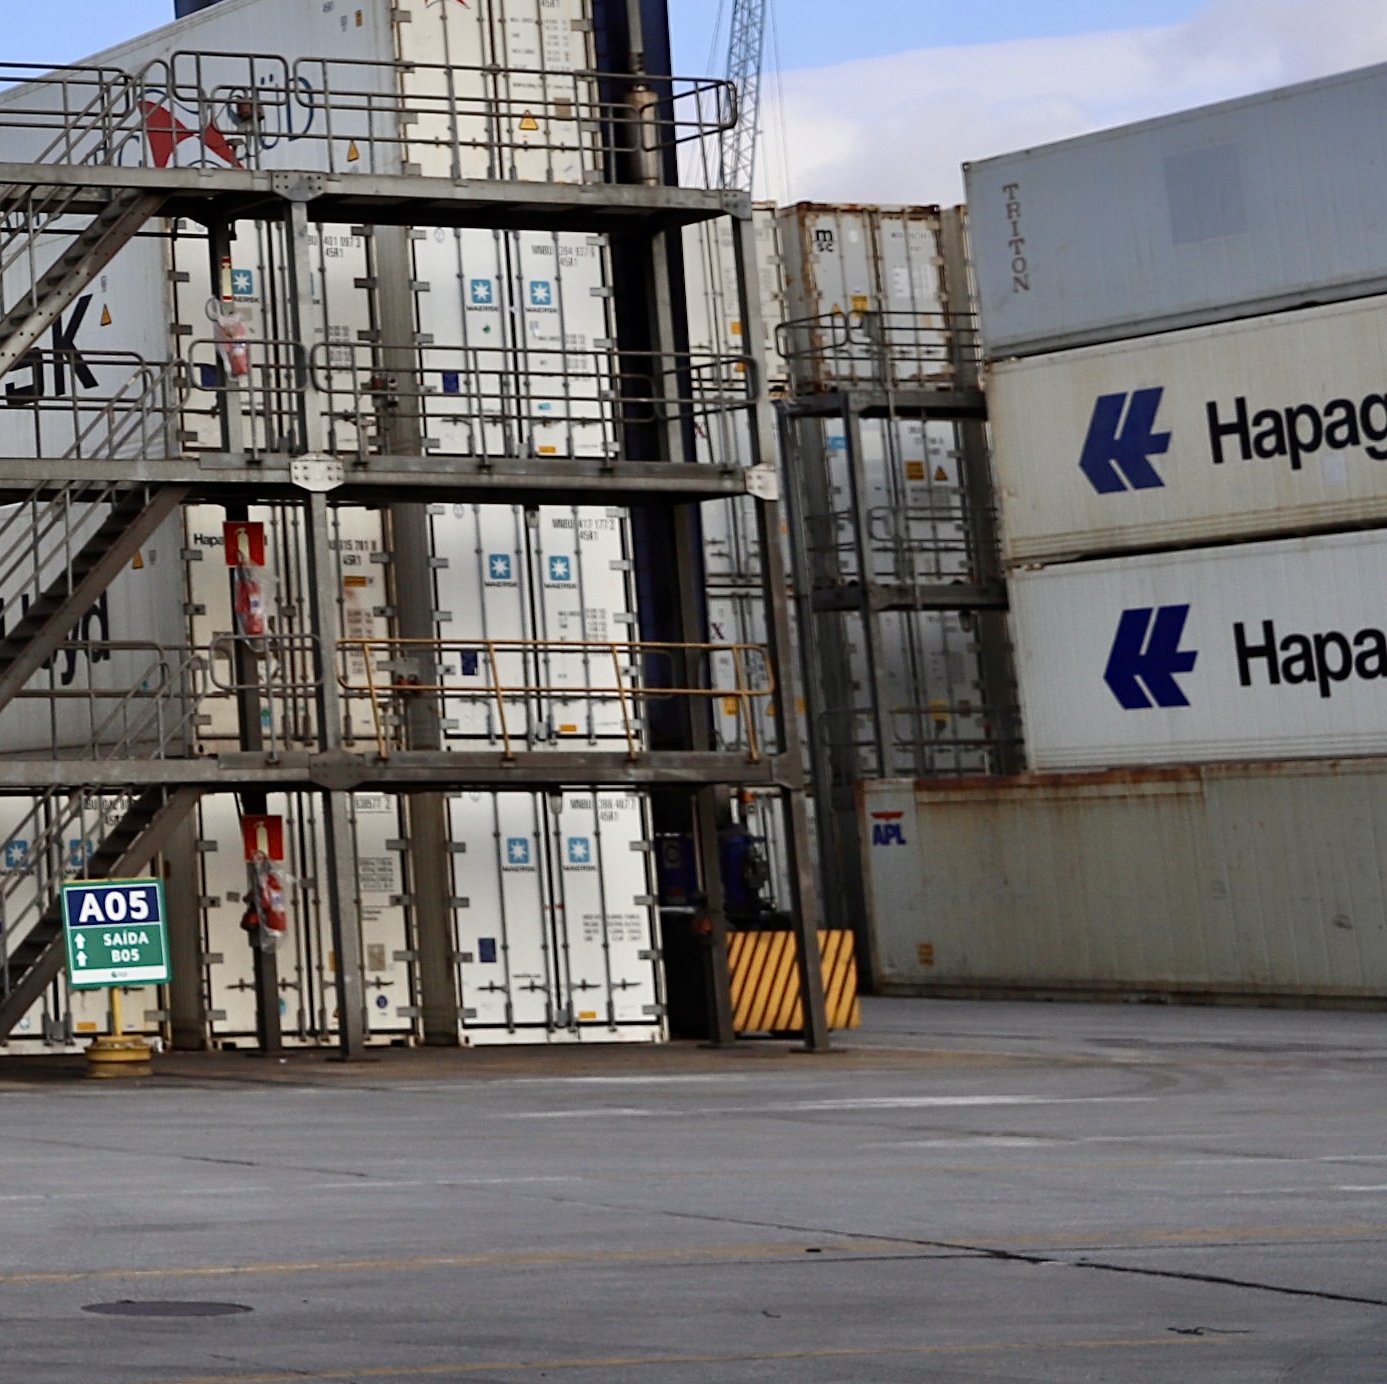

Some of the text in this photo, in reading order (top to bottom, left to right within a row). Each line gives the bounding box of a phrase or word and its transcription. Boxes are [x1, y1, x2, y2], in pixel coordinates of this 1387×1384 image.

[1003, 183, 1030, 294] TRITON
[1206, 393, 1387, 470] Hapag
[872, 823, 907, 846] APL
[78, 889, 149, 923] A05
[103, 928, 150, 947] SAÍDA
[111, 948, 141, 963] B05
